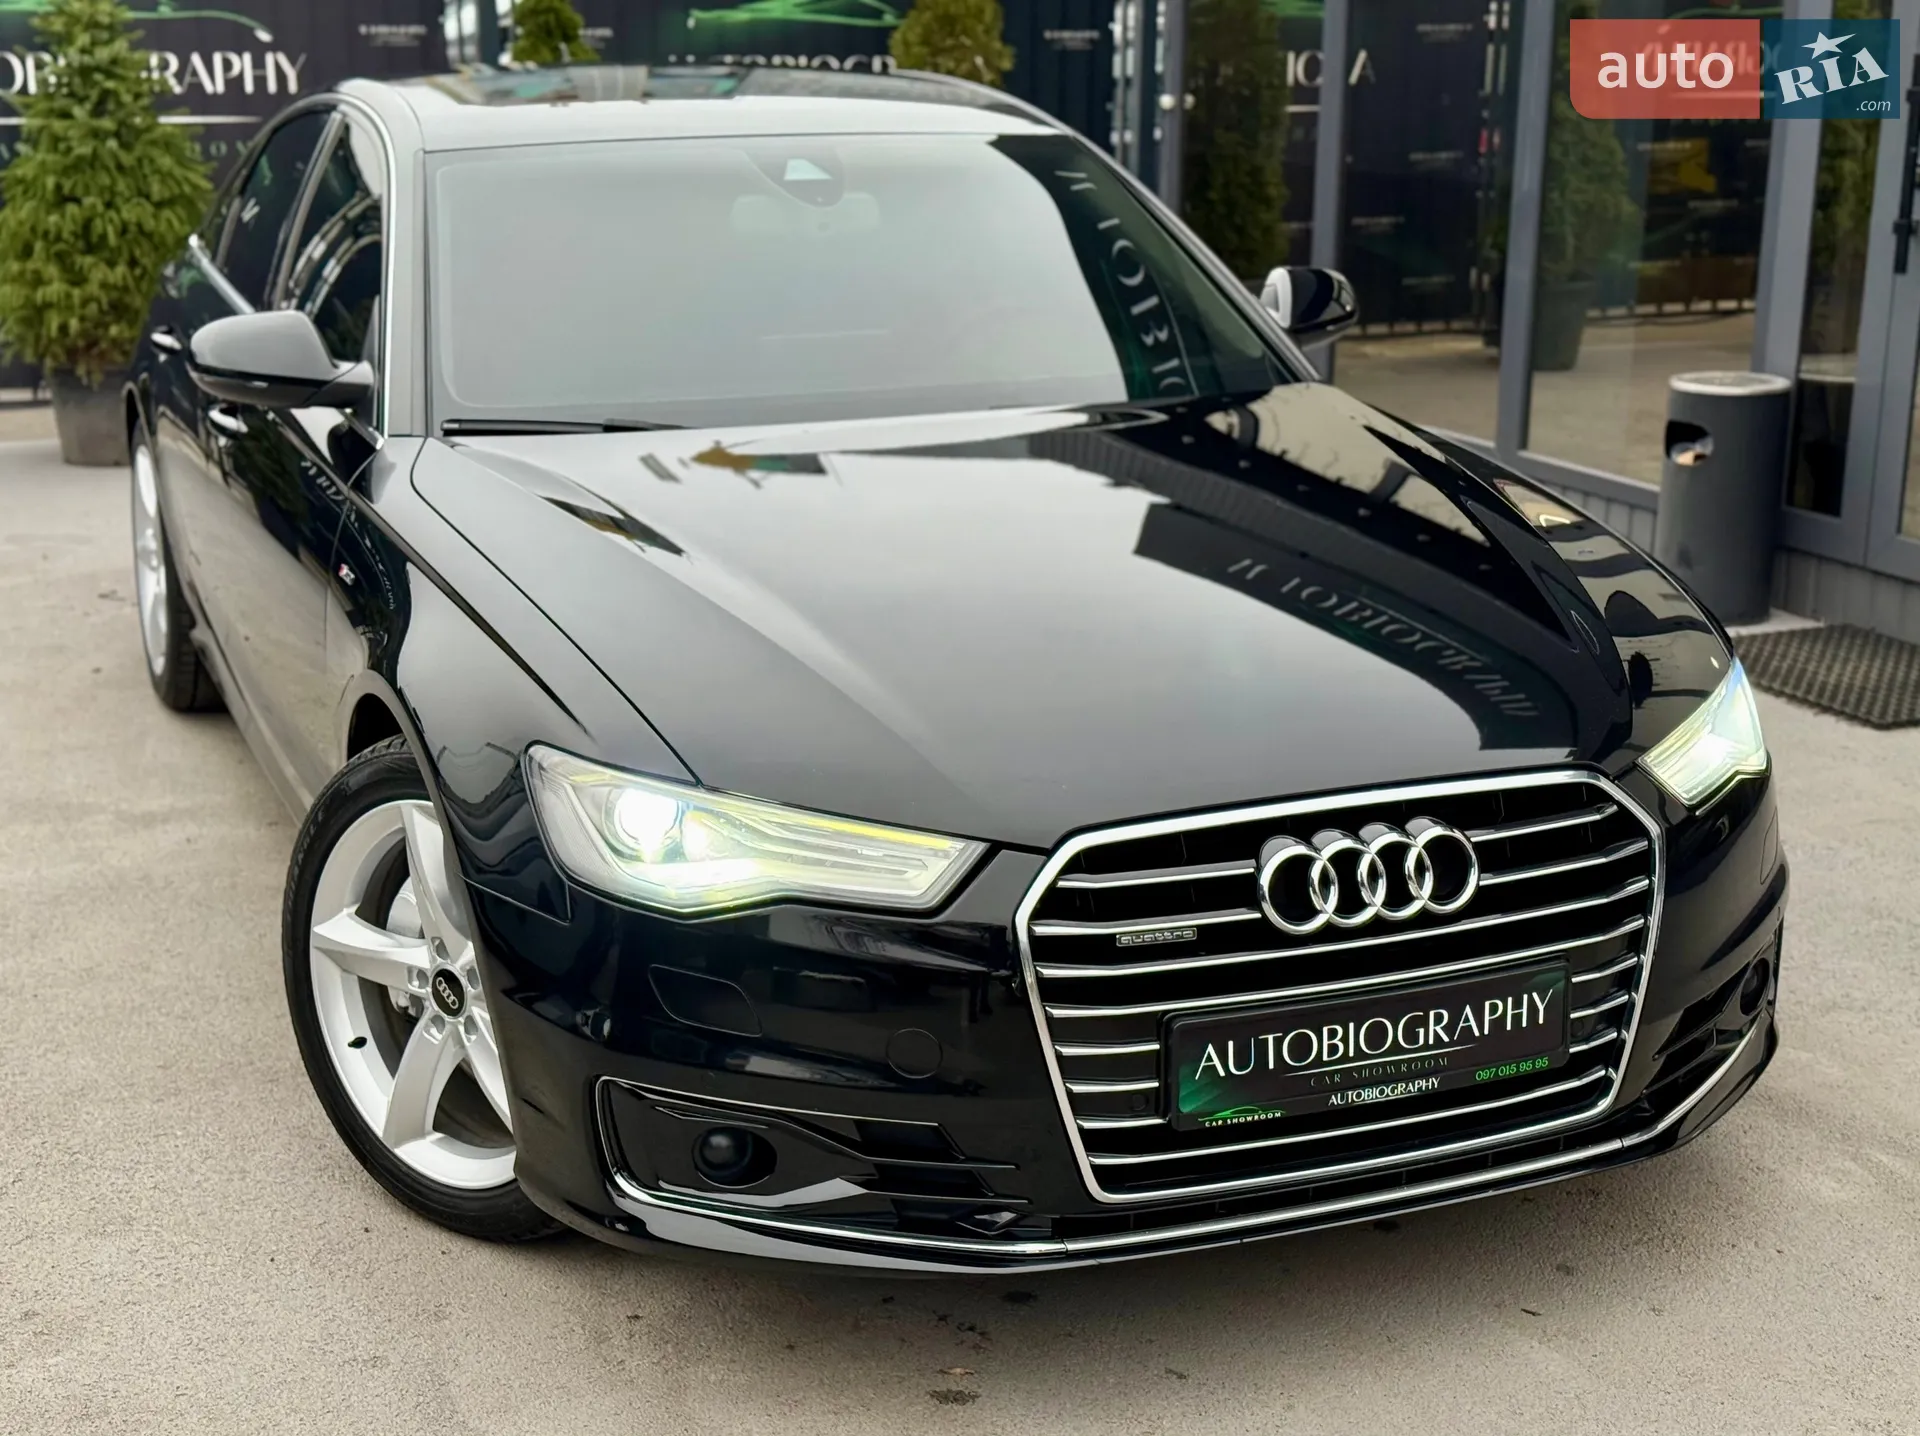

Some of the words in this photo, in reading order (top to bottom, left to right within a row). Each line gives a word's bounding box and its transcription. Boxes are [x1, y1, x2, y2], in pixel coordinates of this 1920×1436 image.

[1120, 930, 1194, 945] quattro
[1195, 988, 1553, 1080] AUTOBIOGRAPHY
[1310, 1073, 1342, 1087] CAR
[1351, 1056, 1449, 1079] SHOWROOM
[1475, 1067, 1496, 1081] 097
[1498, 1063, 1517, 1077] 015
[1519, 1059, 1533, 1072] 95
[1535, 1056, 1549, 1069] 95
[1328, 1076, 1441, 1105] AUTOBIOGRAPHY
[1204, 1118, 1225, 1127] CAR
[1227, 1111, 1281, 1124] SHOWROOM
